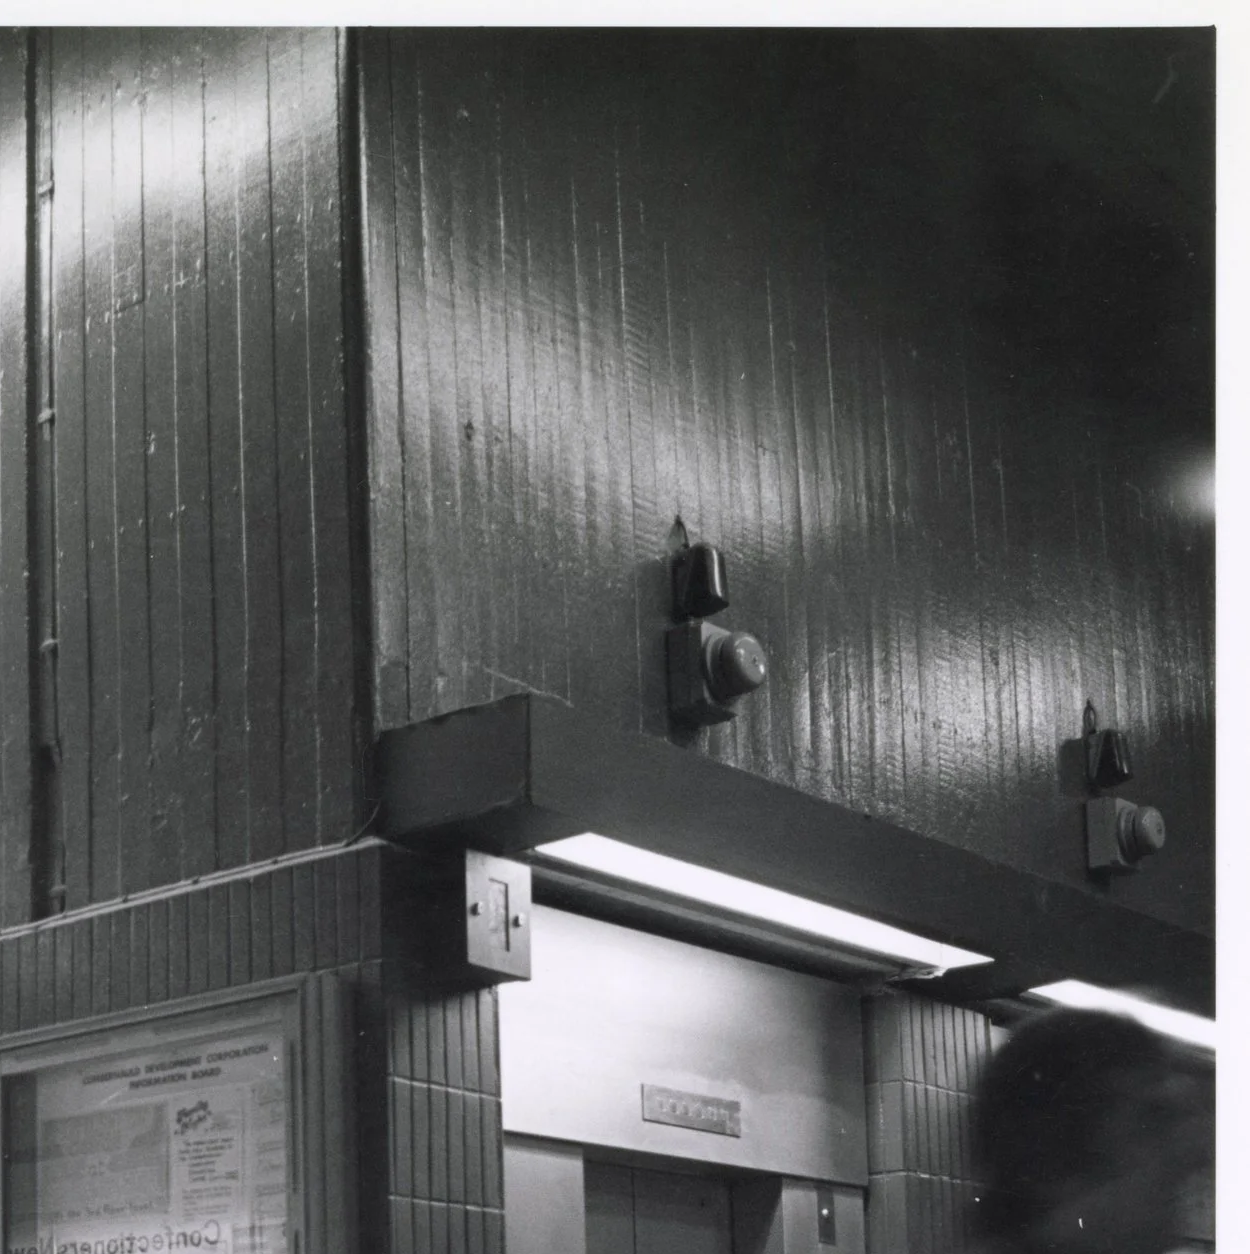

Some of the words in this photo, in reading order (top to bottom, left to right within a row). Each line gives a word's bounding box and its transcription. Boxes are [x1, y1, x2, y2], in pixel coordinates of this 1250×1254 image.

[145, 1056, 203, 1074] DEVELOPMENT
[206, 1043, 269, 1064] CORPORATION
[129, 1071, 188, 1090] INFORMATION
[190, 1066, 222, 1081] BOARD
